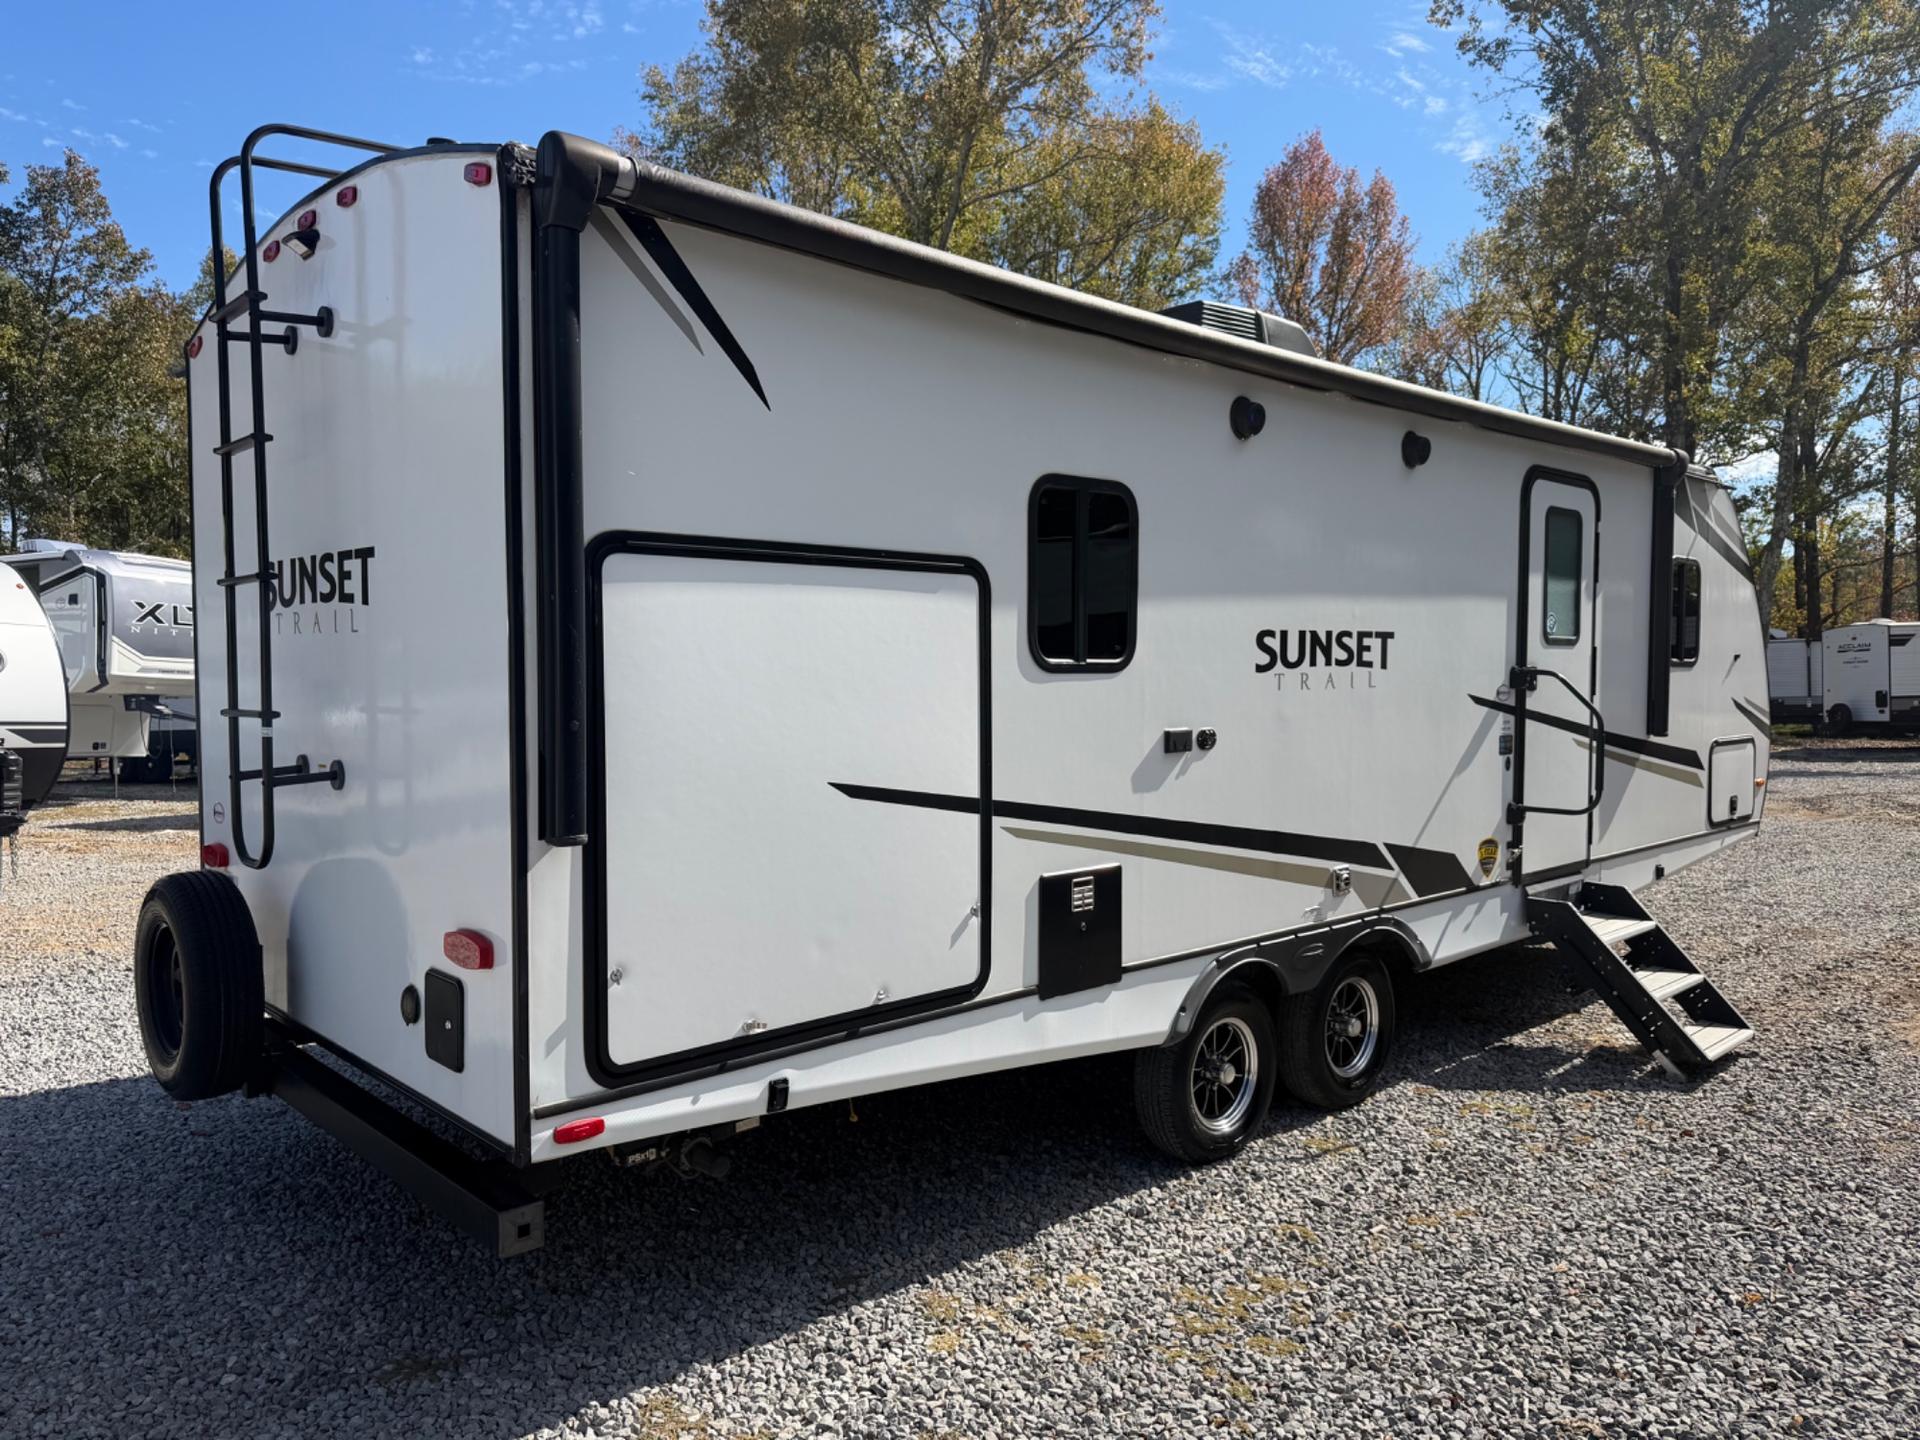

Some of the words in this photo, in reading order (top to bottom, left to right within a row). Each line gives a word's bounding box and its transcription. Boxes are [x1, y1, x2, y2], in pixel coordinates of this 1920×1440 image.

[130, 626, 193, 637] NIT
[275, 608, 359, 634] TRAIL
[1255, 629, 1395, 673] SUNSET
[1274, 671, 1377, 691] TRAIL
